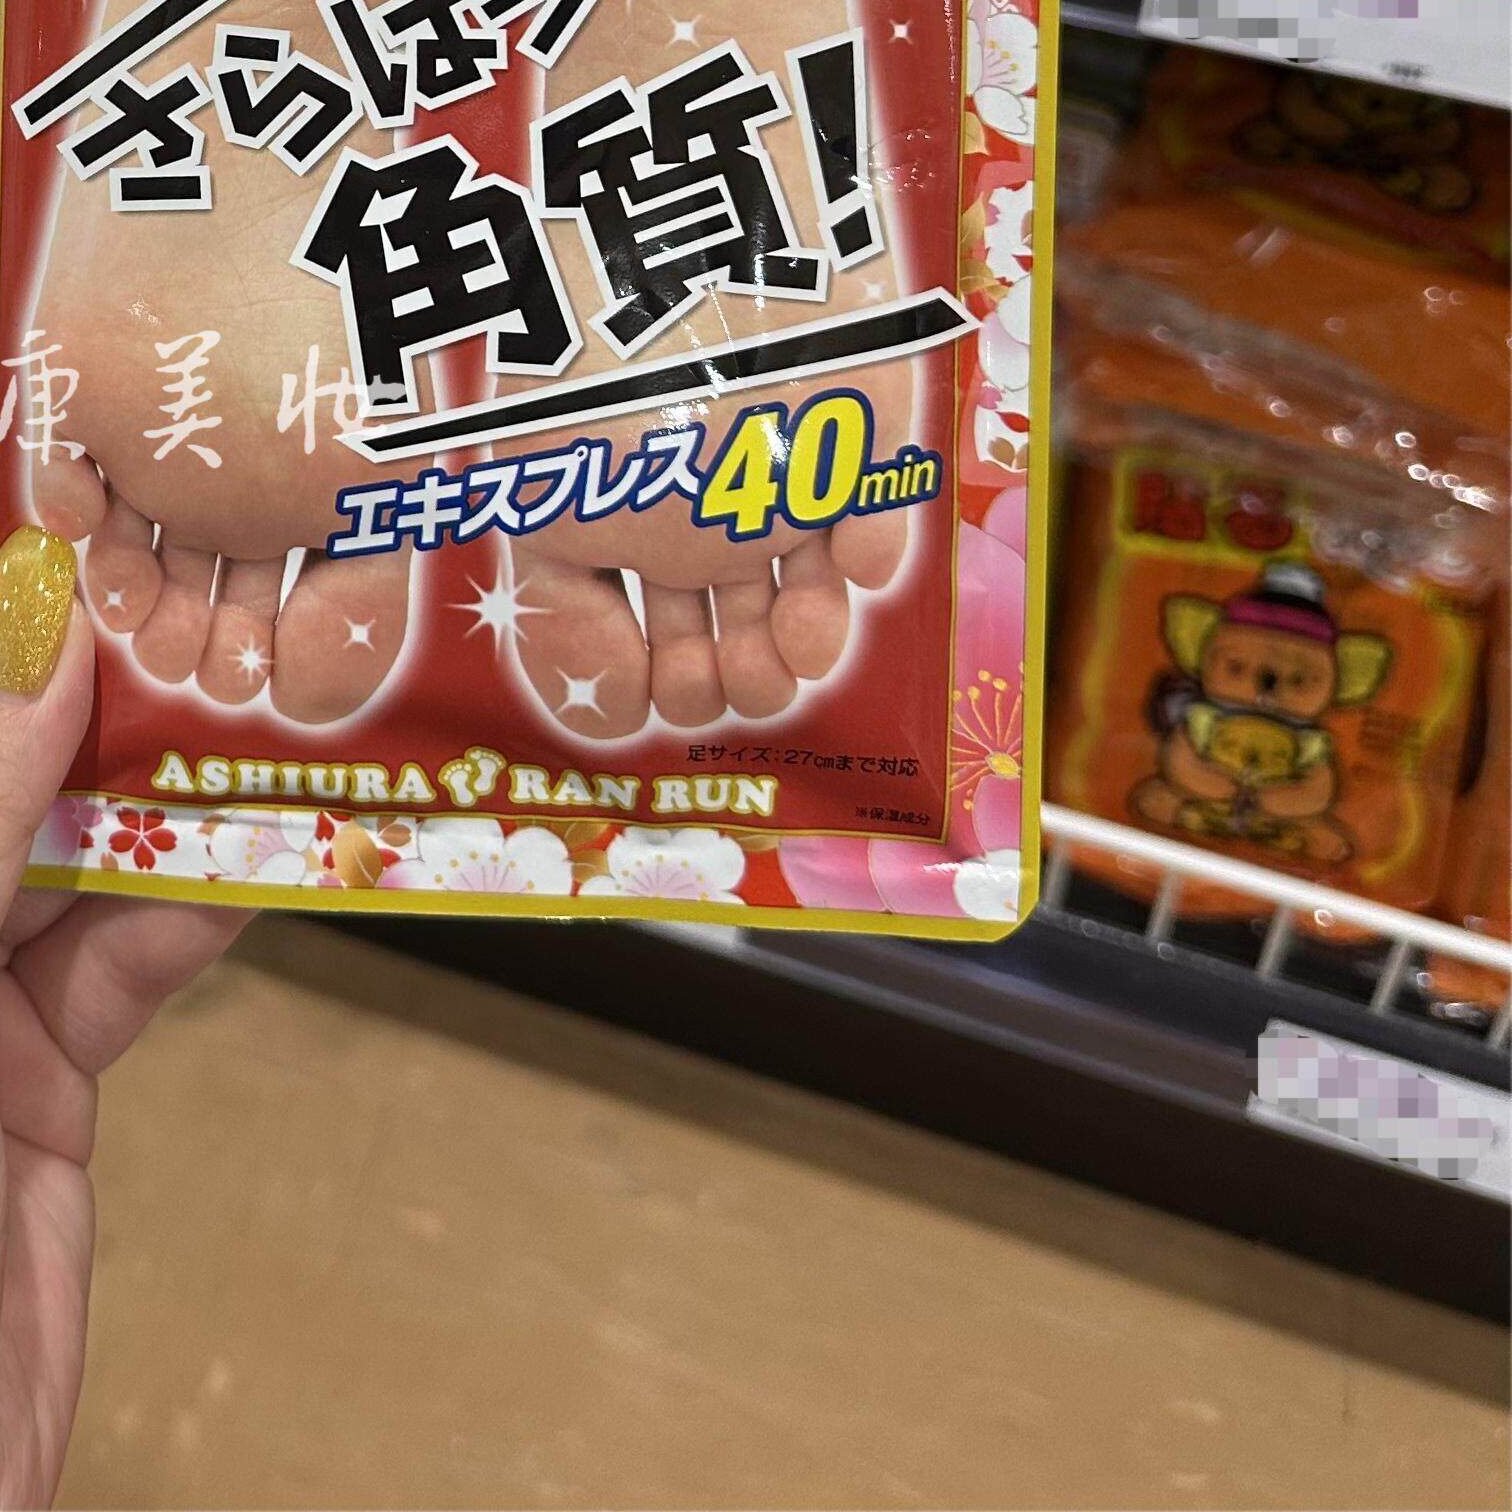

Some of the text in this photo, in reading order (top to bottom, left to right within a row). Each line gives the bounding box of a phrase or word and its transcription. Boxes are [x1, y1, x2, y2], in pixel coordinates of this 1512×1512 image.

[298, 35, 880, 413] 角質!
[152, 750, 779, 818] ASHIURA RAN RUN
